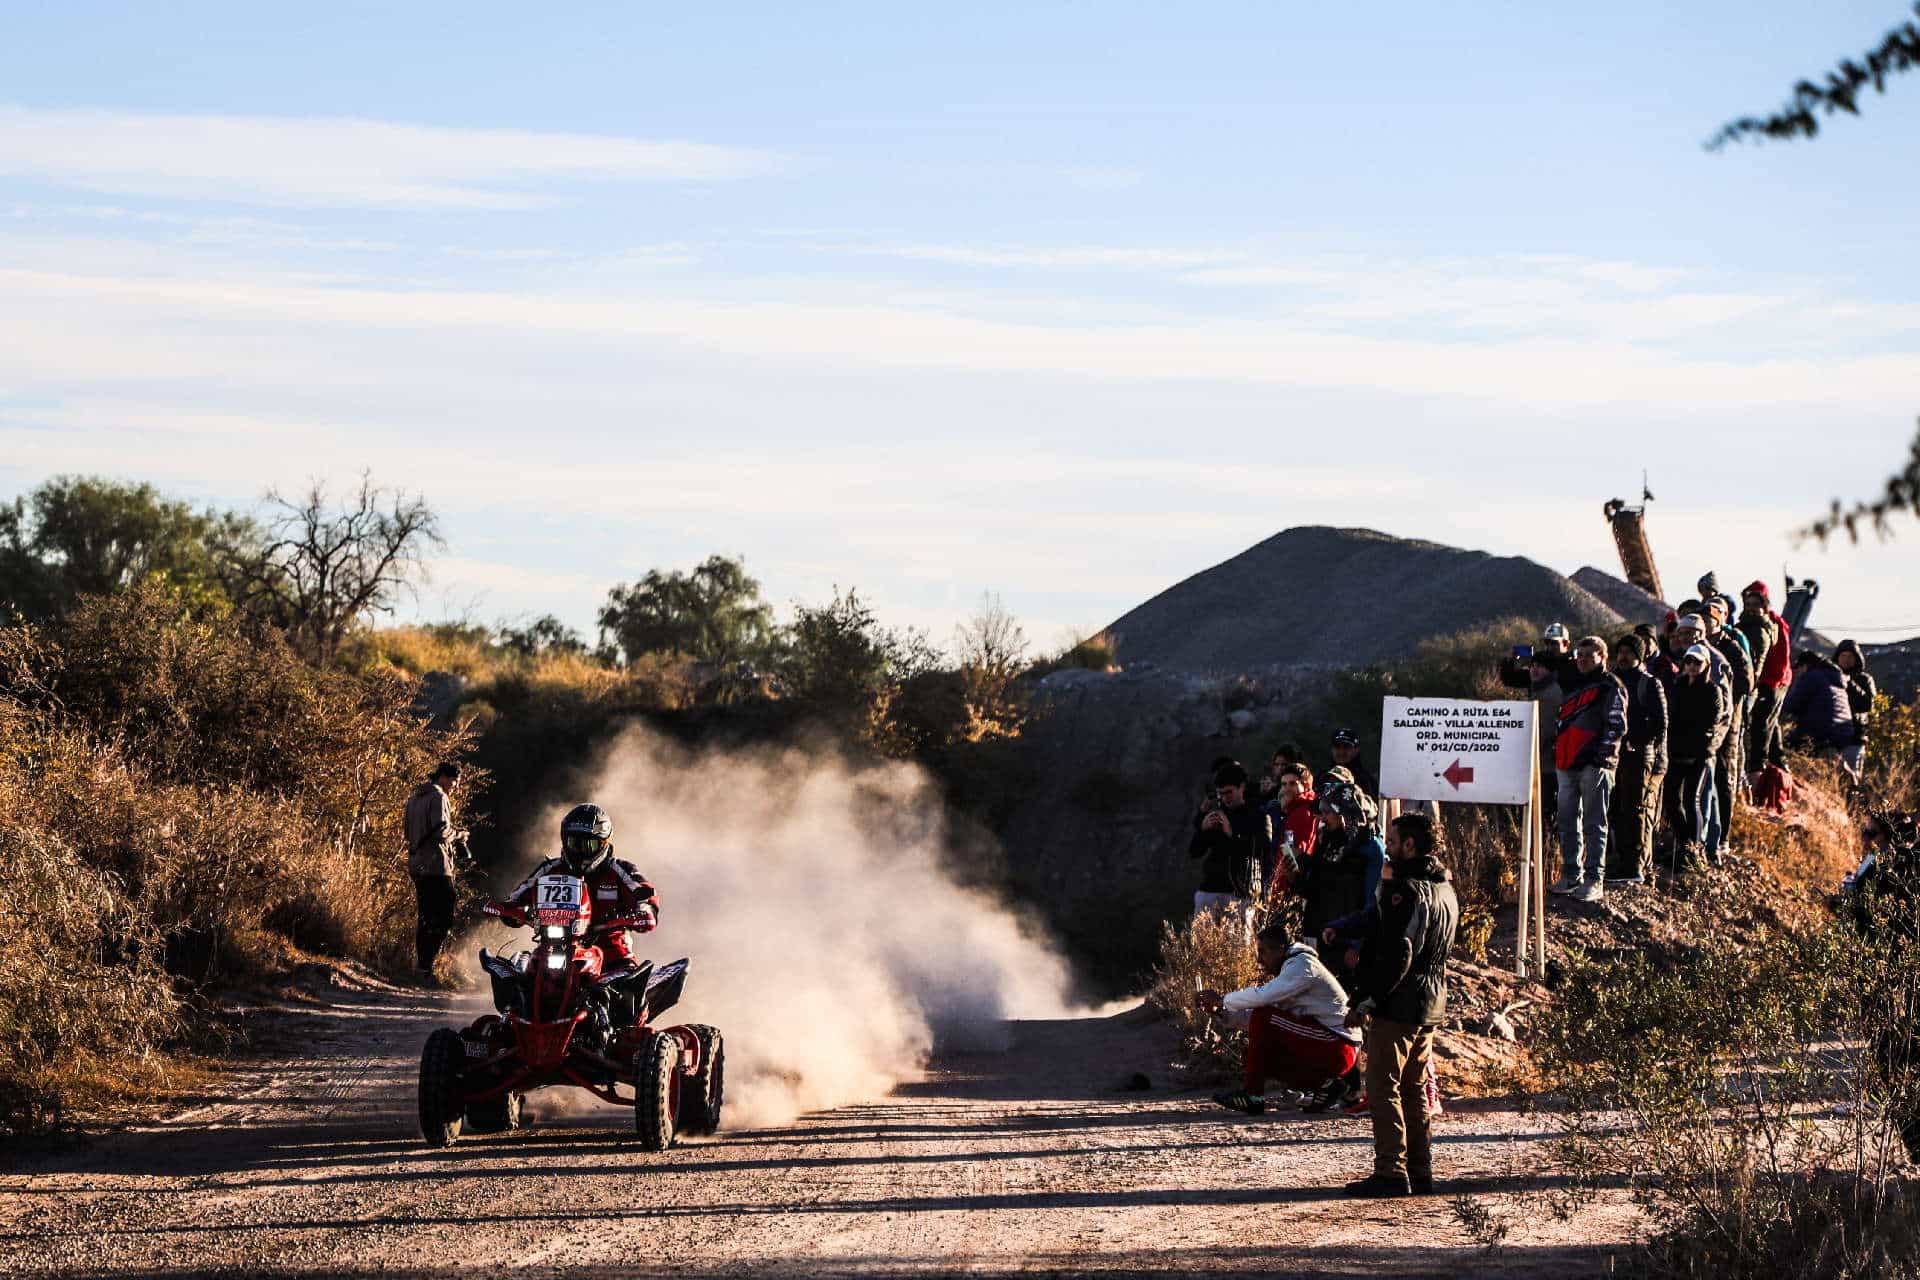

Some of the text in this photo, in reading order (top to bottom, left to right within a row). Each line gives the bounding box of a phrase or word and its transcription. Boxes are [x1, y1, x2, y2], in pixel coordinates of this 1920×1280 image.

[1407, 708, 1449, 716] CAMINO
[1452, 708, 1459, 716] A
[1492, 709, 1511, 717] E64
[1393, 718, 1434, 728] SALDÁN
[1445, 720, 1474, 728] VILLA
[1478, 720, 1524, 728] ALLENDE
[1416, 731, 1500, 740] ORD. MUNICIPAL
[1431, 743, 1500, 752] 012/CD/2020
[544, 886, 573, 902] 723
